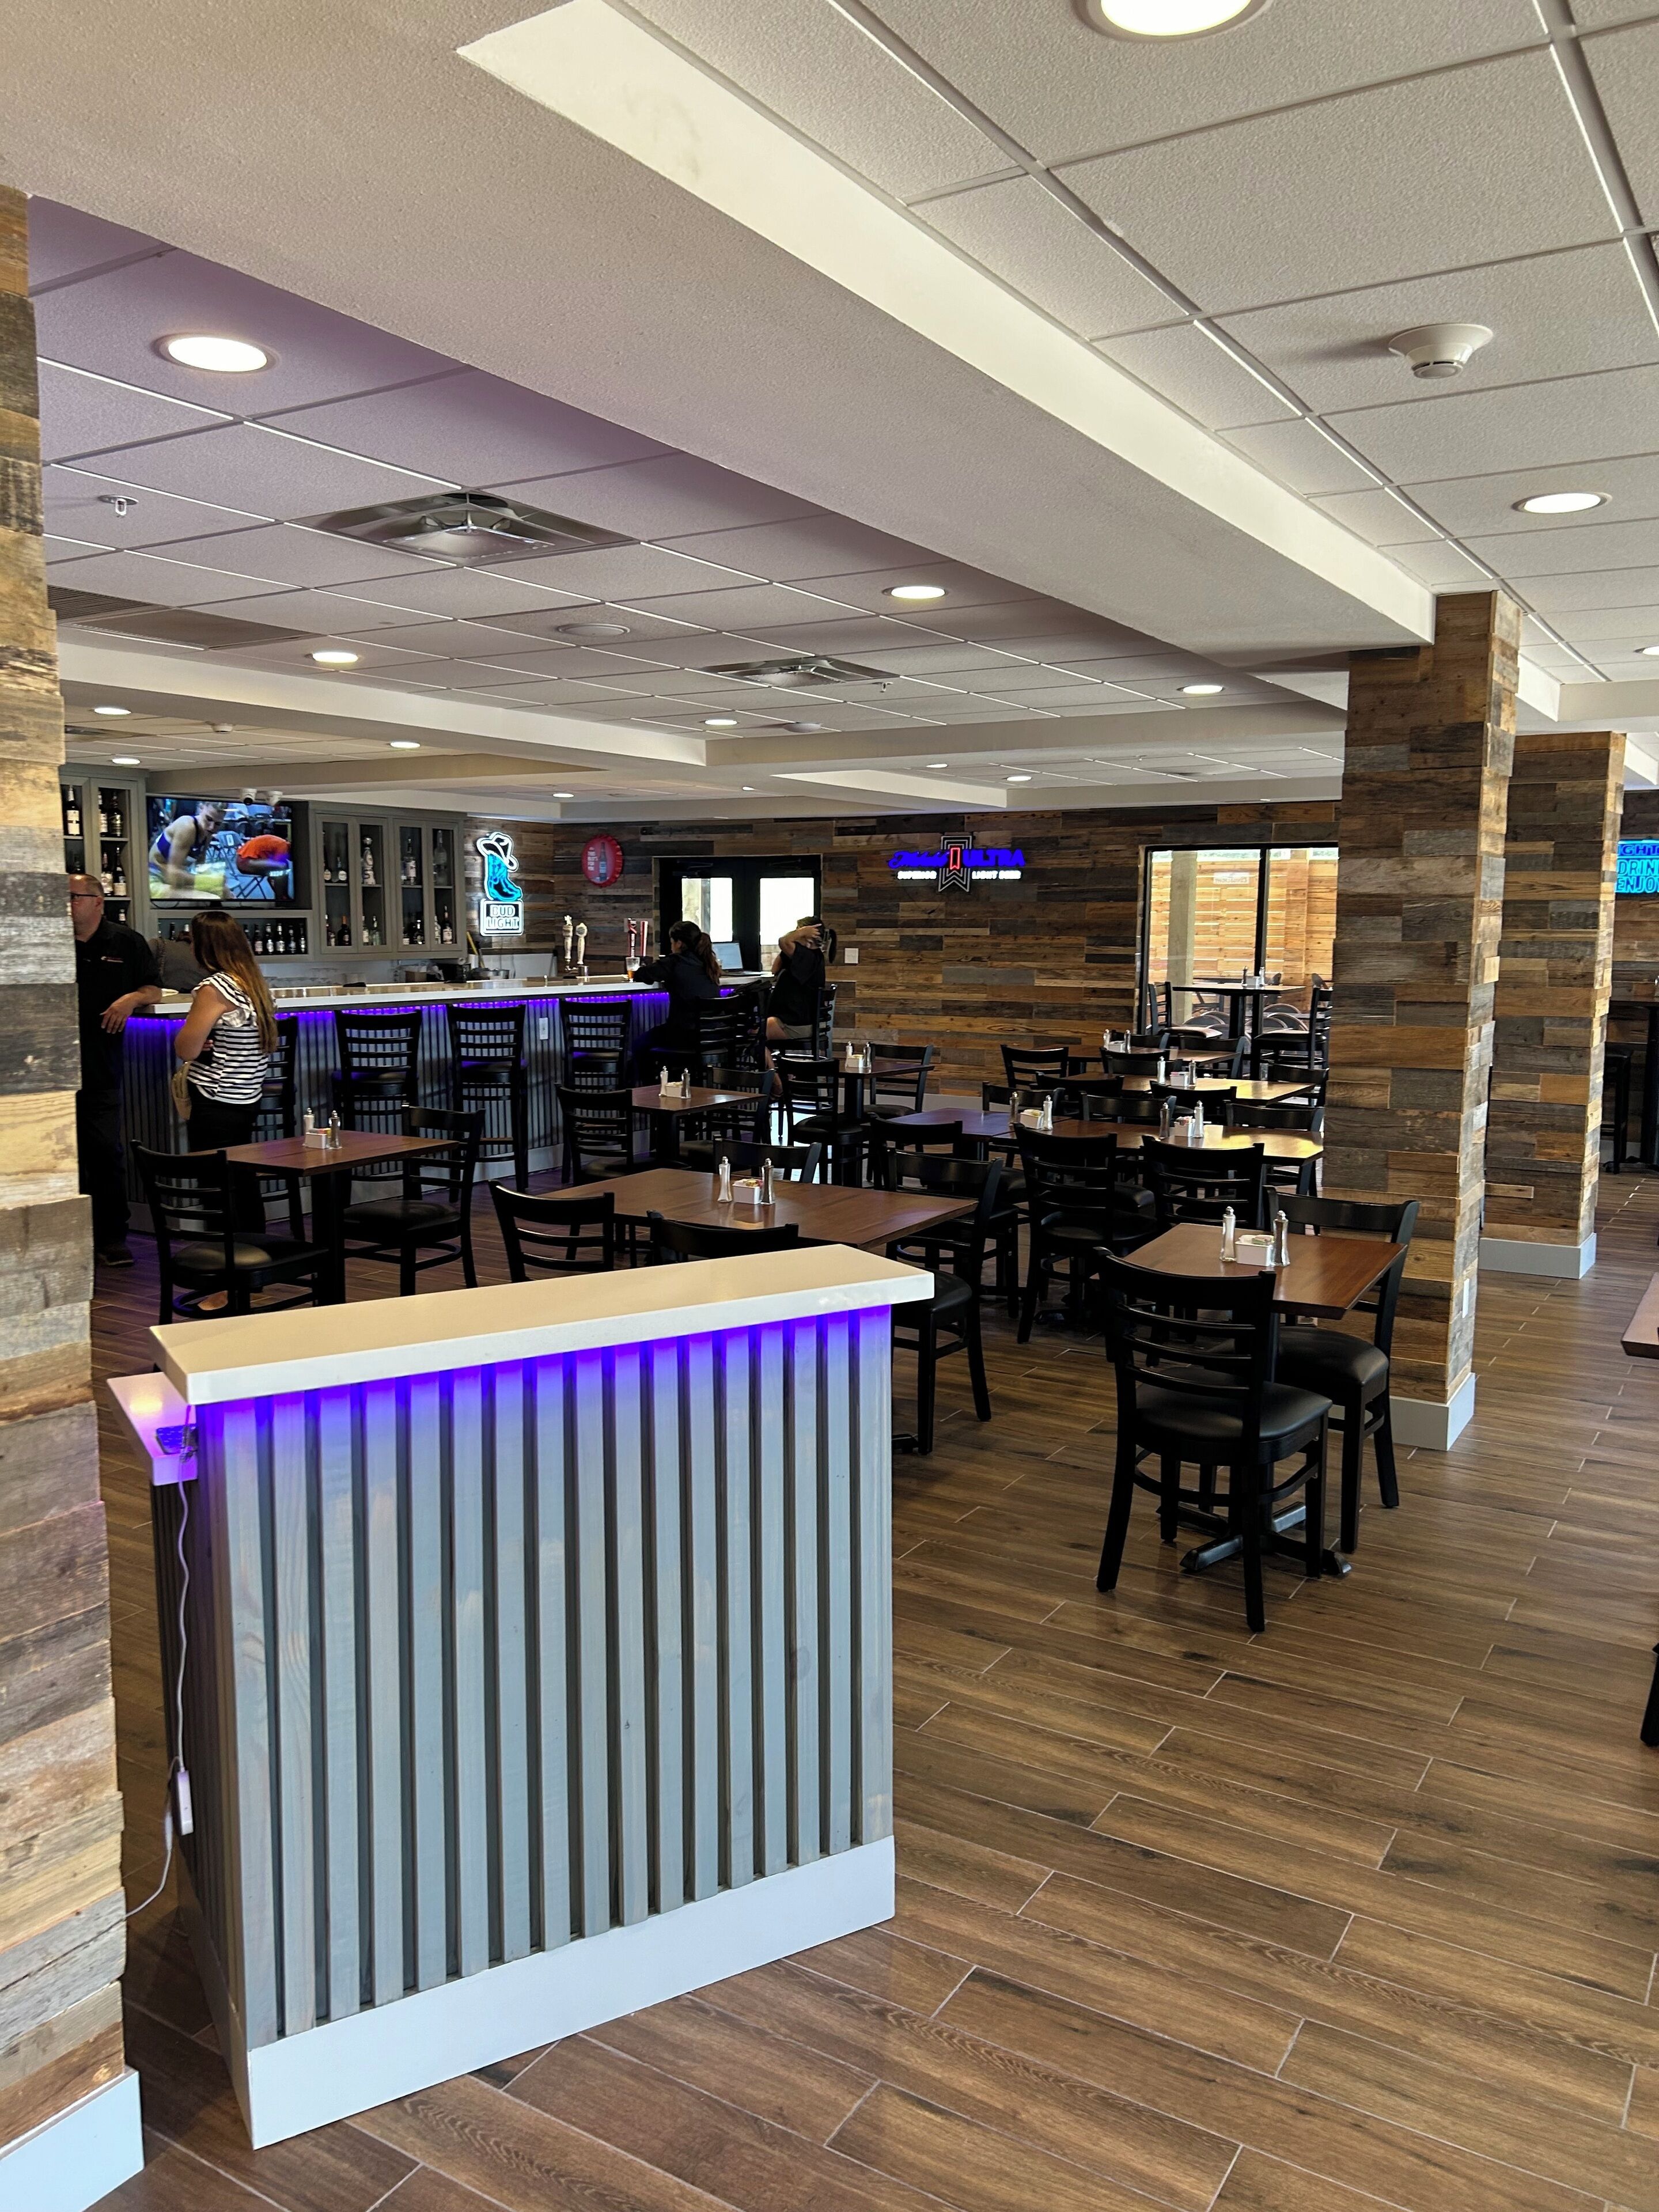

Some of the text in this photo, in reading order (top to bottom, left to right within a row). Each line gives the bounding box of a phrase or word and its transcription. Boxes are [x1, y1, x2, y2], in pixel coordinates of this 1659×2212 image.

[962, 849, 1025, 867] ULTRA
[1618, 860, 1659, 876] DRIN
[1616, 876, 1659, 892] ENJO
[491, 905, 514, 916] BUD
[487, 917, 519, 929] LIGHT
